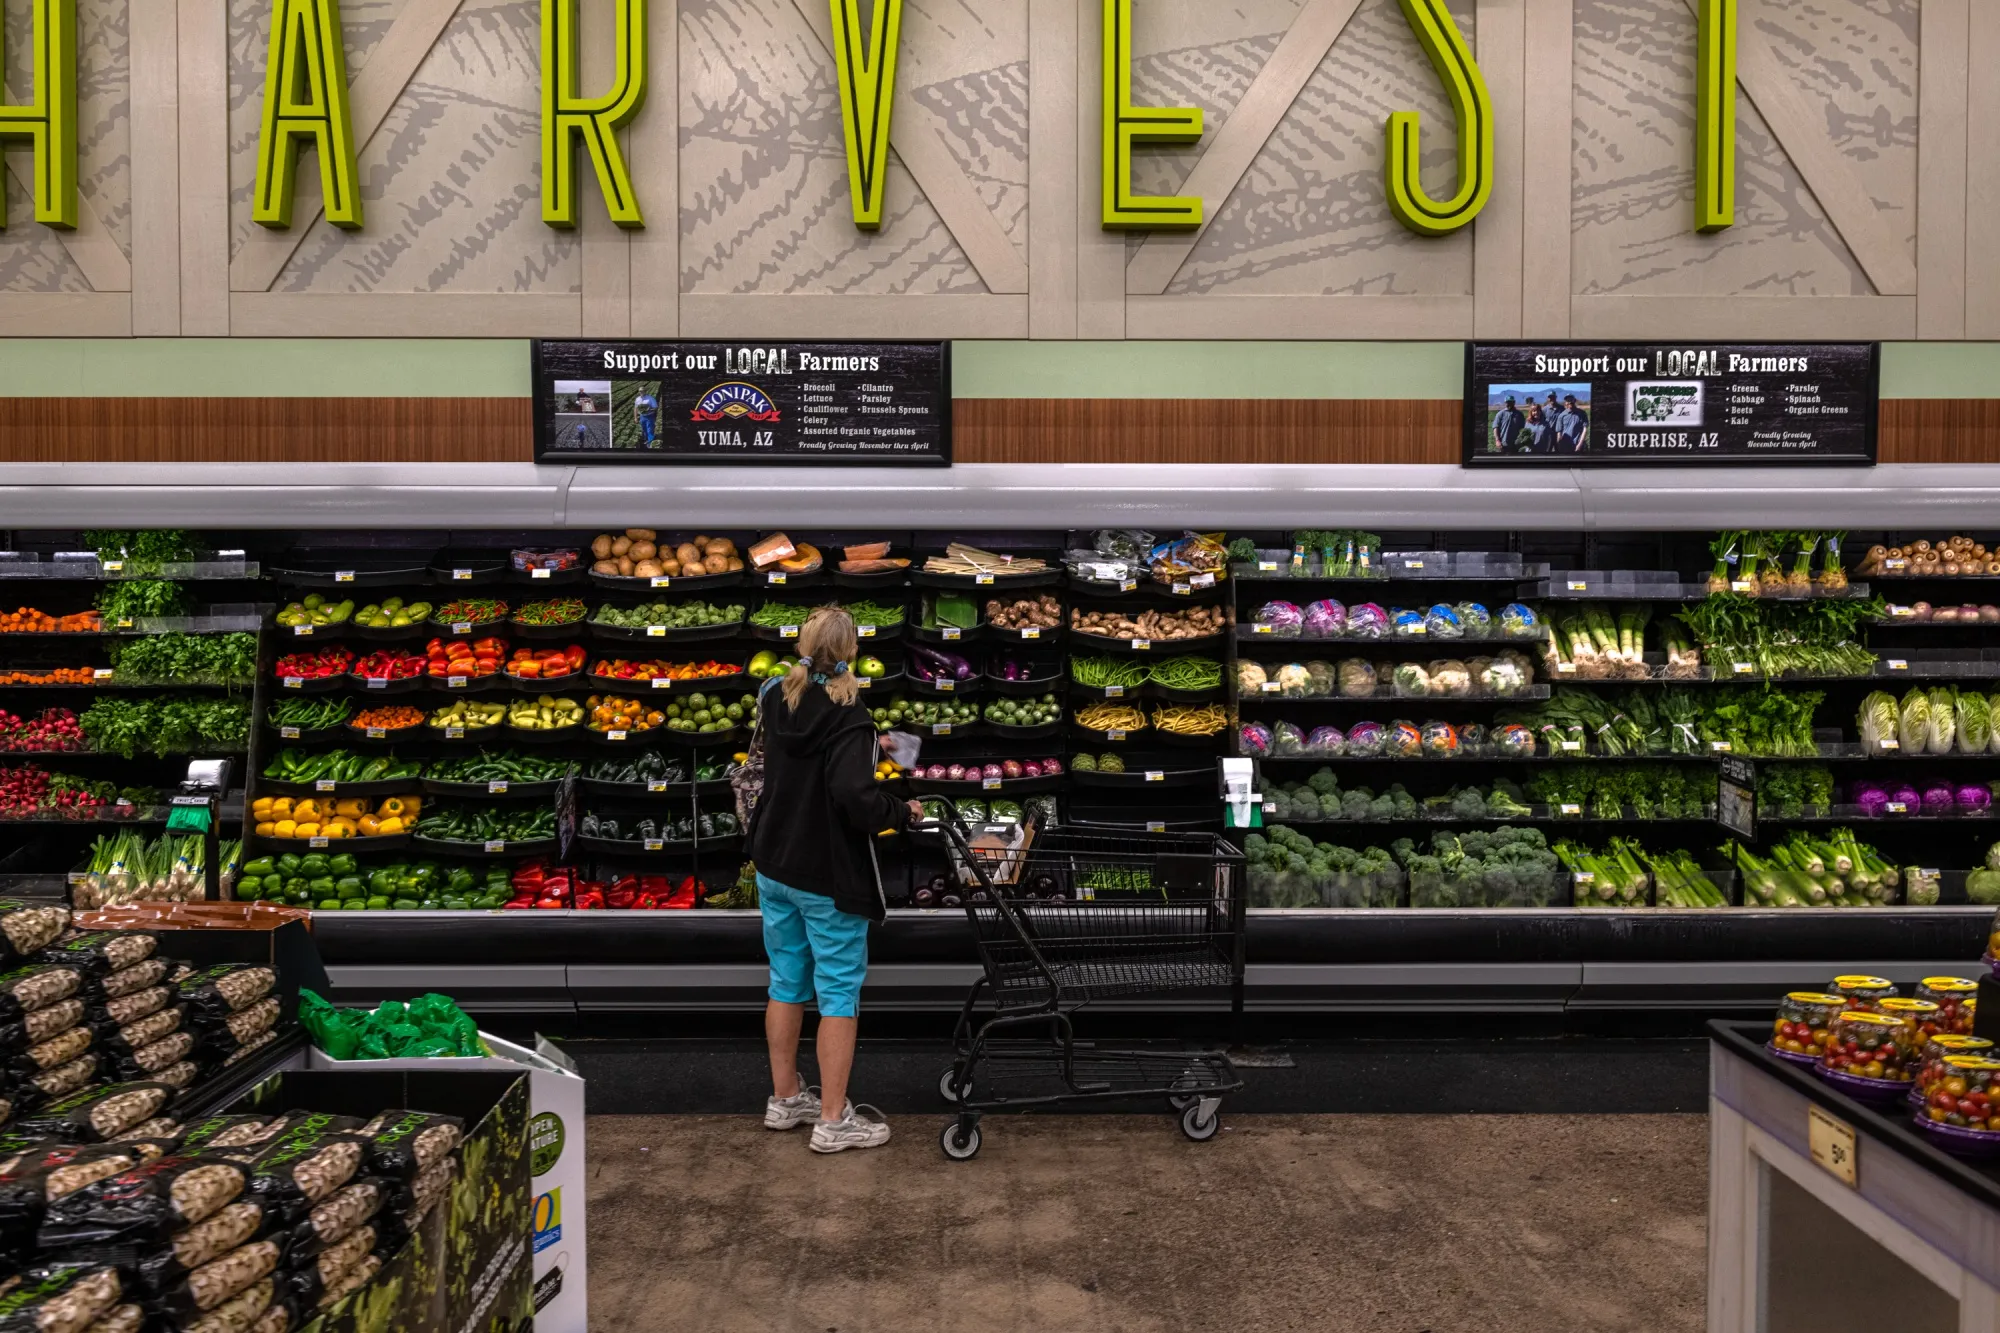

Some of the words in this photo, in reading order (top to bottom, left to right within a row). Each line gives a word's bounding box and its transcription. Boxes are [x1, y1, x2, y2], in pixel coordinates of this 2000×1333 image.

[604, 350, 679, 372] Support
[685, 355, 717, 369] our
[726, 348, 792, 375] LOCAL
[799, 352, 879, 371] Farmers
[1535, 354, 1609, 376] Support
[1616, 358, 1648, 372] our
[1656, 350, 1722, 376] LOCAL
[1729, 354, 1808, 373] Farmers
[803, 383, 836, 392] Broccoli
[861, 384, 894, 392] Cilantro
[1732, 384, 1759, 392] Greens
[1789, 384, 1820, 394] Parsley
[702, 387, 769, 413] BONIPAK
[803, 394, 834, 402] Lettuce
[861, 395, 892, 404] Parsley
[1731, 395, 1765, 405] Cabbage
[1789, 395, 1821, 404] Spinach
[803, 405, 849, 413] Cauliflower
[861, 405, 896, 414] Brussels
[898, 405, 929, 415] Sprouts
[1731, 406, 1753, 414] Beets
[1789, 405, 1820, 415] Organic
[1821, 405, 1849, 414] Greens
[803, 416, 829, 426] Celery
[1730, 416, 1749, 425] Kale
[803, 426, 838, 435] Assorted
[840, 427, 871, 437] Organic
[873, 427, 916, 437] Vegetables
[1753, 431, 1781, 440] Proudly
[1782, 431, 1812, 440] Growing
[698, 431, 747, 448] YUMA,
[753, 431, 773, 446] AZ
[1607, 433, 1693, 449] SURPRISE,
[1699, 433, 1719, 447] AZ
[1747, 440, 1780, 448] November
[1781, 440, 1797, 448] thru
[1799, 440, 1818, 449] April
[798, 441, 827, 451] Proudly
[828, 441, 857, 451] Growing
[911, 442, 930, 451] April
[531, 1129, 559, 1151] ATURE
